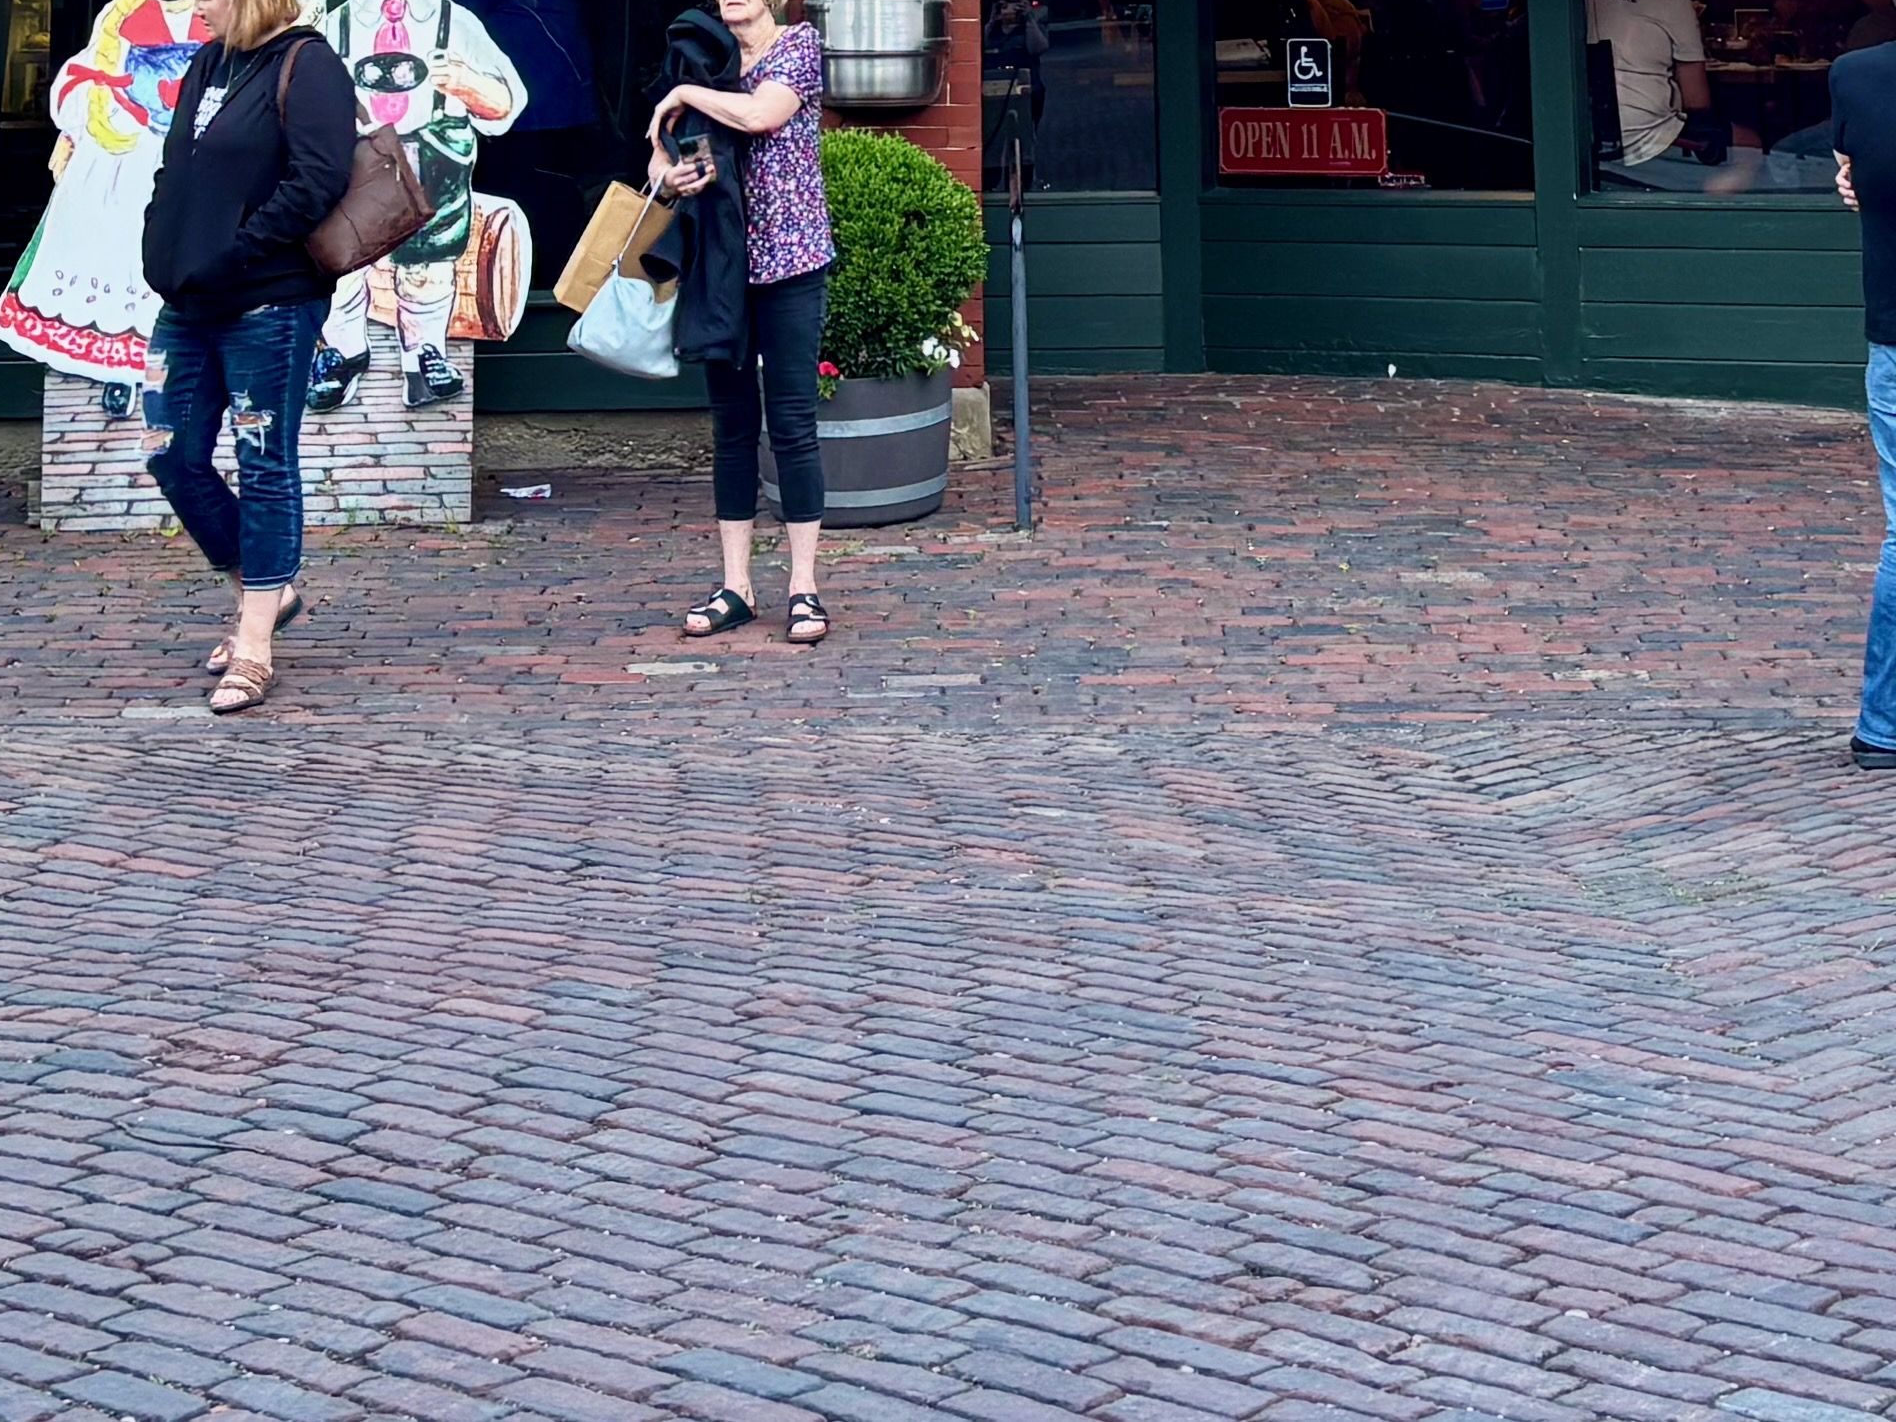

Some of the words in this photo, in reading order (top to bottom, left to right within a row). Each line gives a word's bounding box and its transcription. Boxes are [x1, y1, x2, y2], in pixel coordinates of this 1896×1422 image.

[1229, 120, 1291, 159] OPEN
[1301, 122, 1320, 159] 11
[1329, 121, 1377, 160] A.M.
